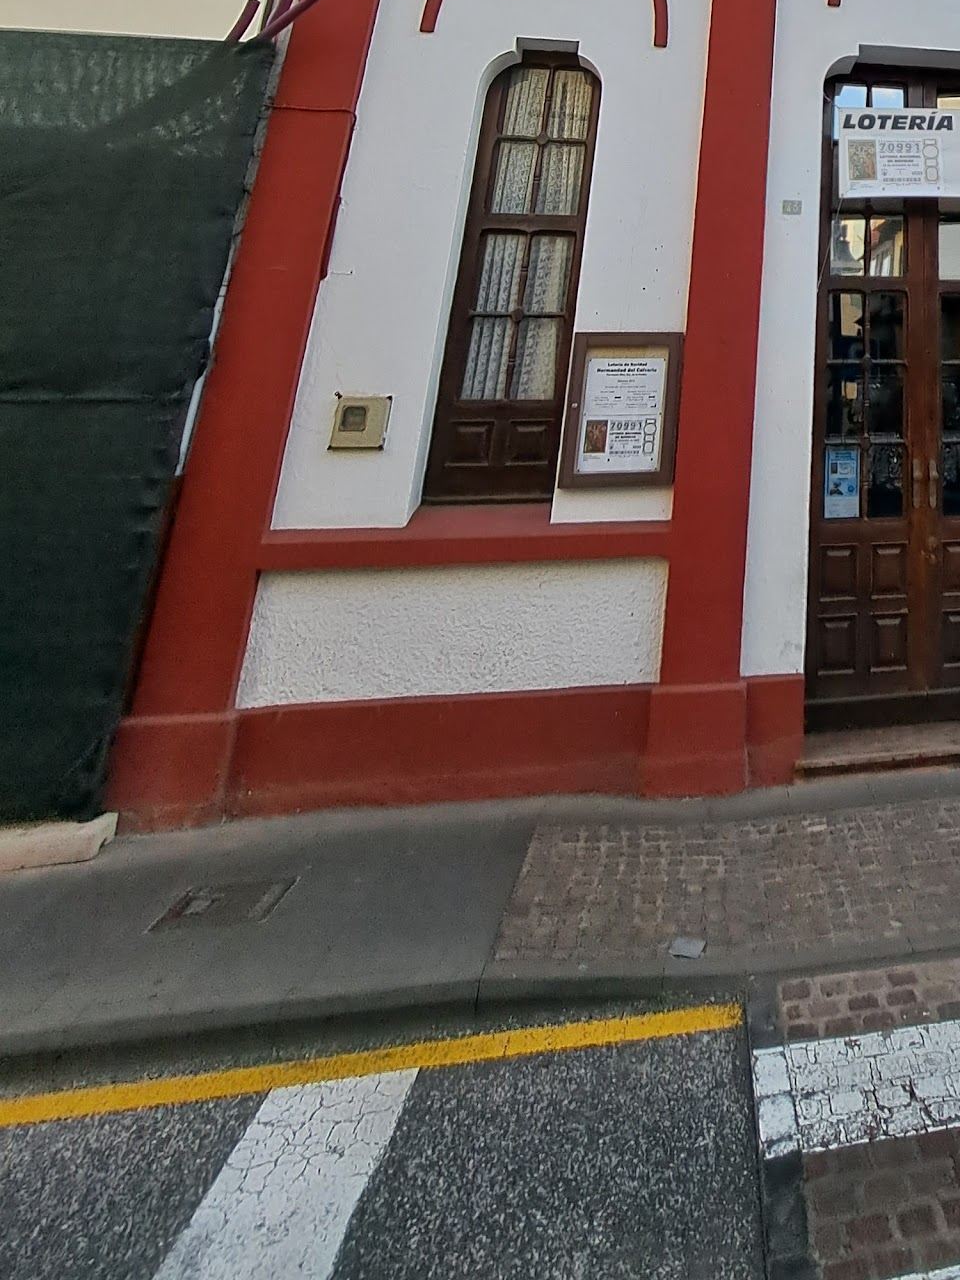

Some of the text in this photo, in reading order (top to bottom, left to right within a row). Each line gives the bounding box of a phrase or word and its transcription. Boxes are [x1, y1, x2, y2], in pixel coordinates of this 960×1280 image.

[842, 111, 953, 131] LOTERÍA
[879, 142, 920, 152] 70991
[610, 421, 642, 431] 70991
